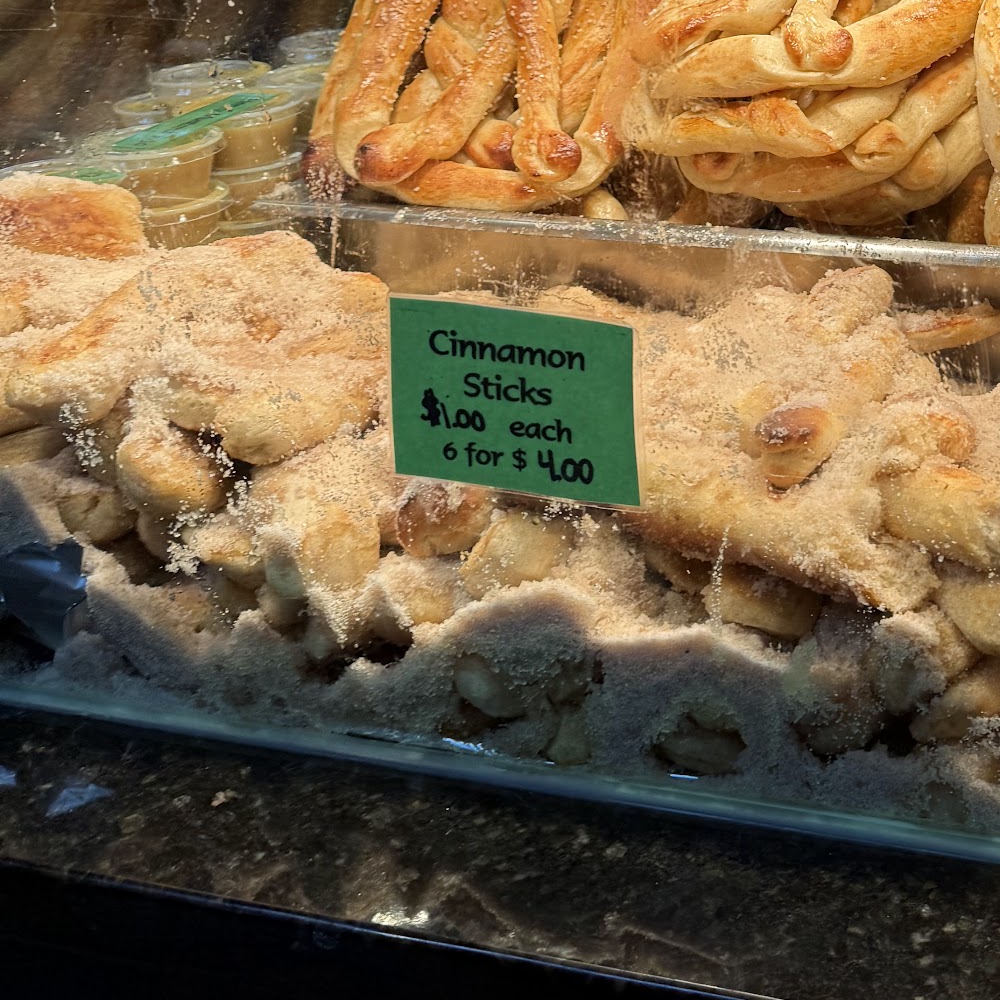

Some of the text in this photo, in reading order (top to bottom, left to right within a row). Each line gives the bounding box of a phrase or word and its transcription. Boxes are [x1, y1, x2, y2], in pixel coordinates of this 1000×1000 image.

[428, 329, 586, 371] Cinnamon
[463, 372, 553, 406] Sticks
[509, 418, 573, 444] each
[442, 442, 459, 461] 6
[464, 442, 504, 467] for
